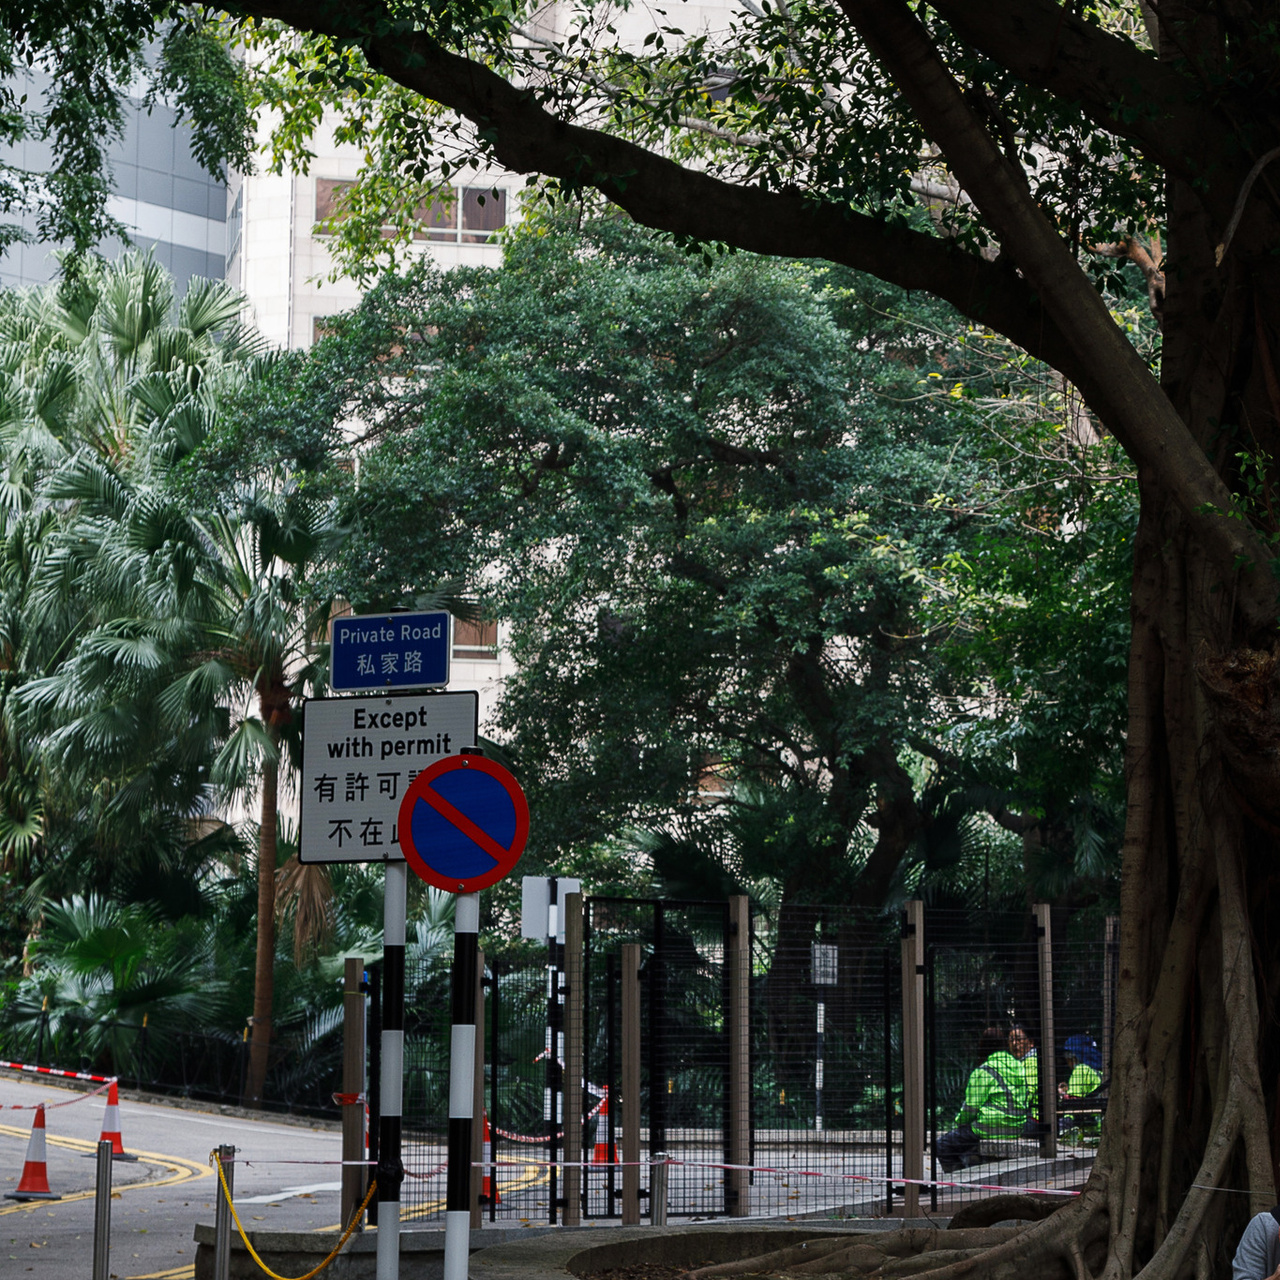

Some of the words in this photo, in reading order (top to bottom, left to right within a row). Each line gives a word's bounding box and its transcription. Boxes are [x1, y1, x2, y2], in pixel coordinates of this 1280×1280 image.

[340, 626, 395, 645] Private
[401, 622, 442, 641] Road
[357, 650, 423, 675] 私家路
[353, 706, 427, 731] Except
[327, 736, 373, 758] with
[380, 733, 451, 760] permit
